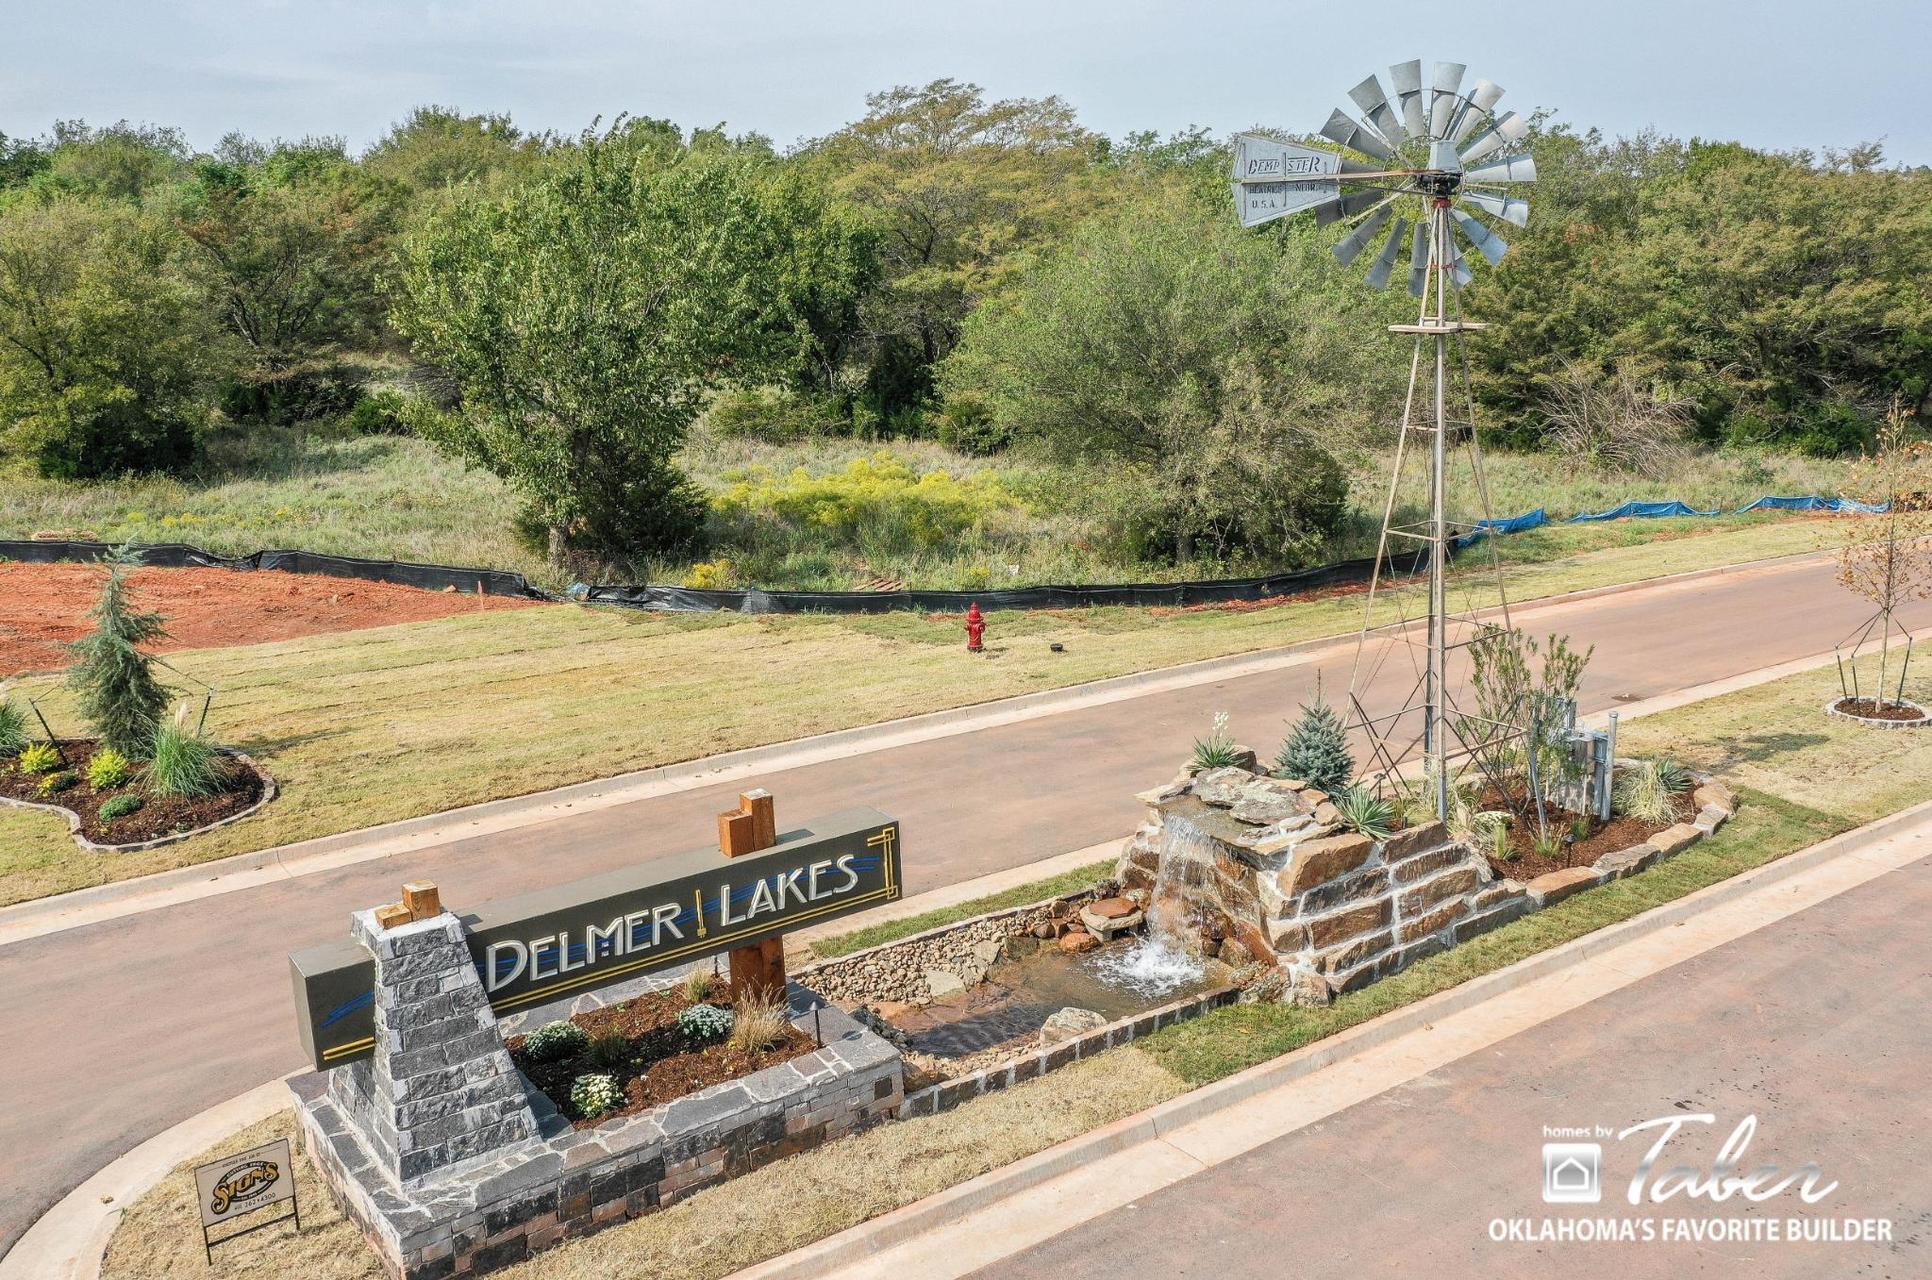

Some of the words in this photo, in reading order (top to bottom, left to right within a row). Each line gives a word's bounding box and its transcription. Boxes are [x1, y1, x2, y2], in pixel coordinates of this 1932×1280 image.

[485, 902, 684, 993] DELMER
[721, 854, 860, 927] LAKES
[211, 1162, 280, 1215] SIGNS
